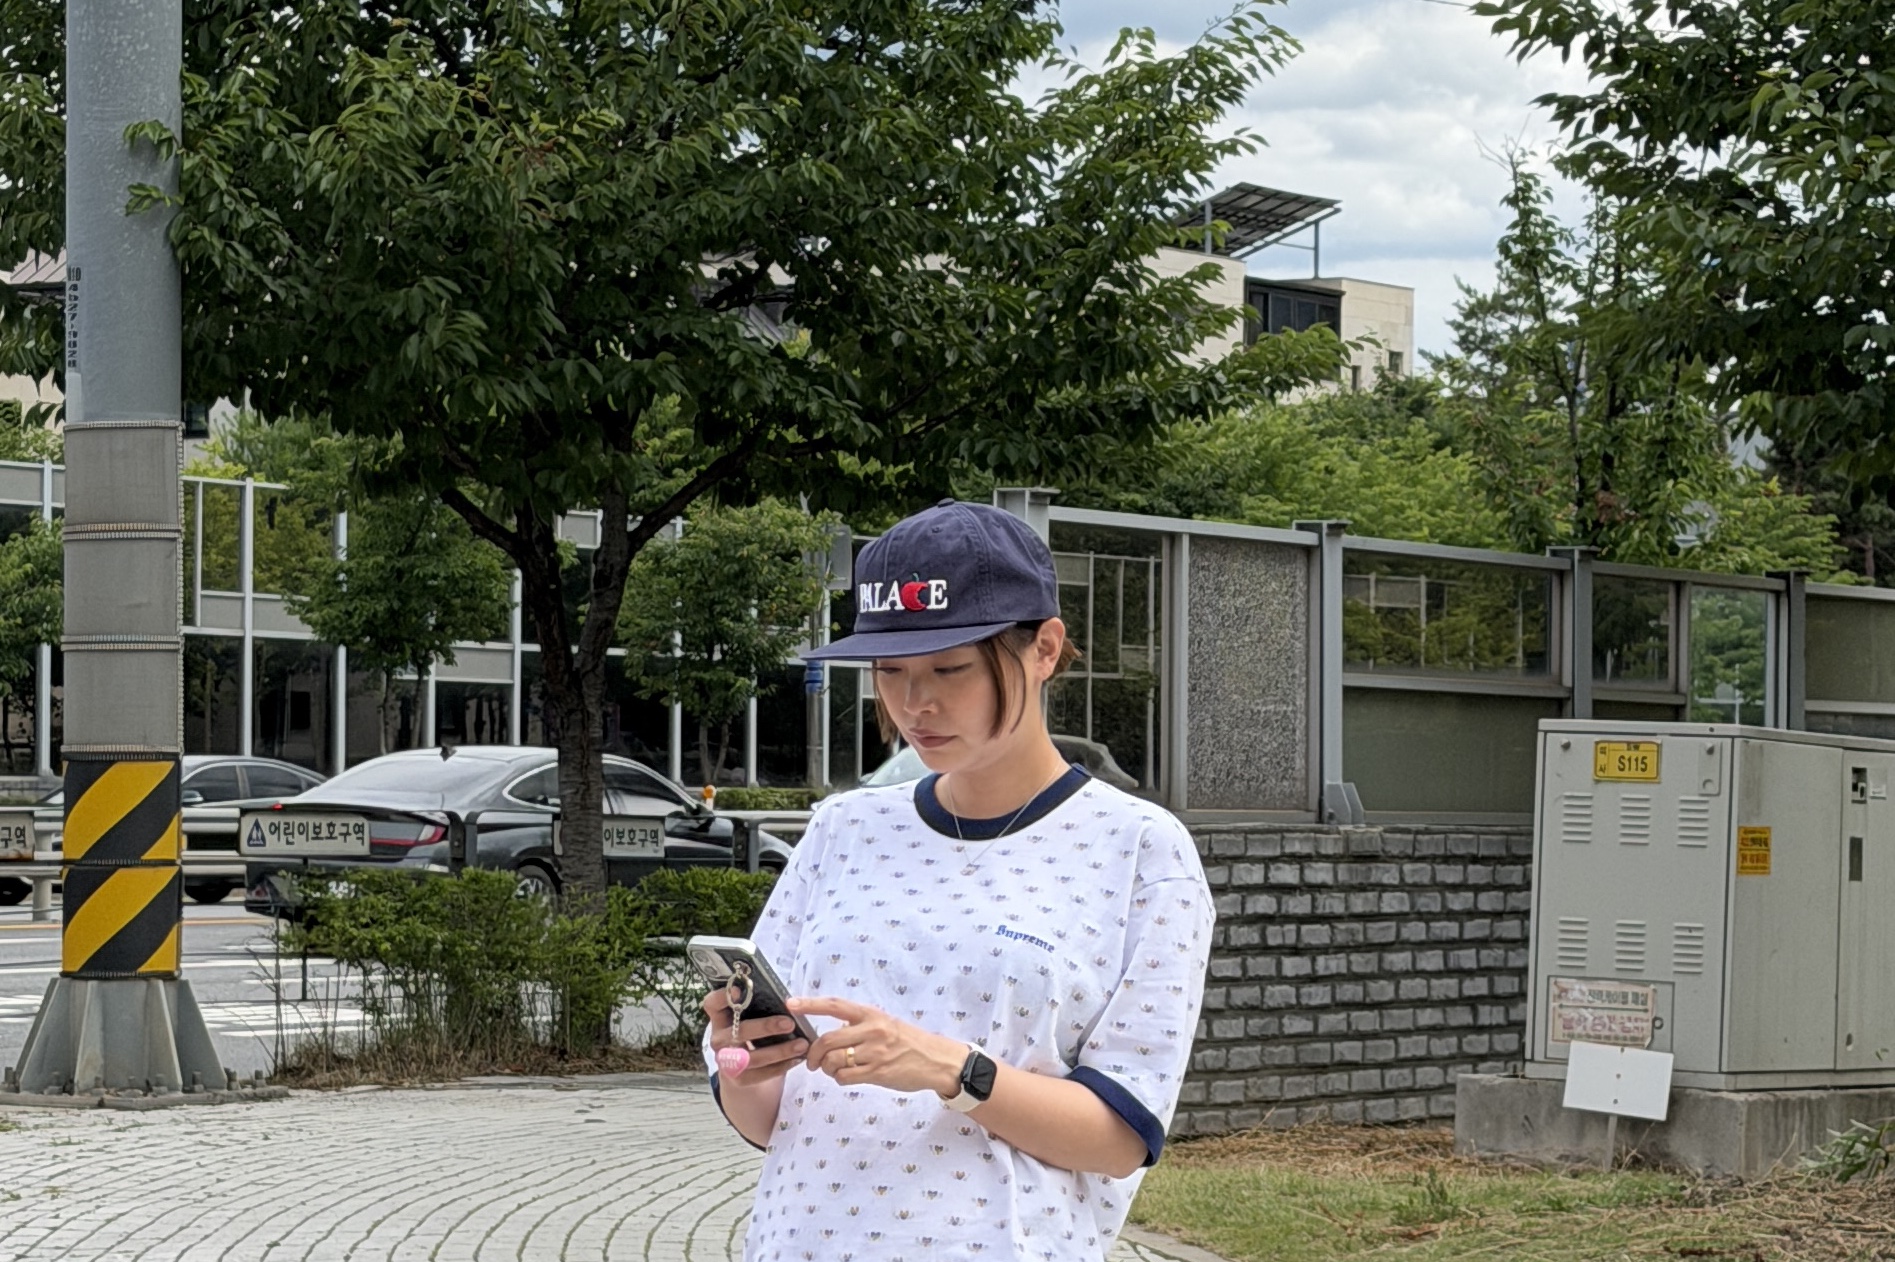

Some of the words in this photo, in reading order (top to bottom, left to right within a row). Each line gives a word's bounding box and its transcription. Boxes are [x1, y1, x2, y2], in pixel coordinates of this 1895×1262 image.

[859, 579, 949, 613] PALACE
[1617, 754, 1648, 772] S115
[268, 820, 366, 846] 어린이보호구역
[995, 924, 1055, 953] Supreme
